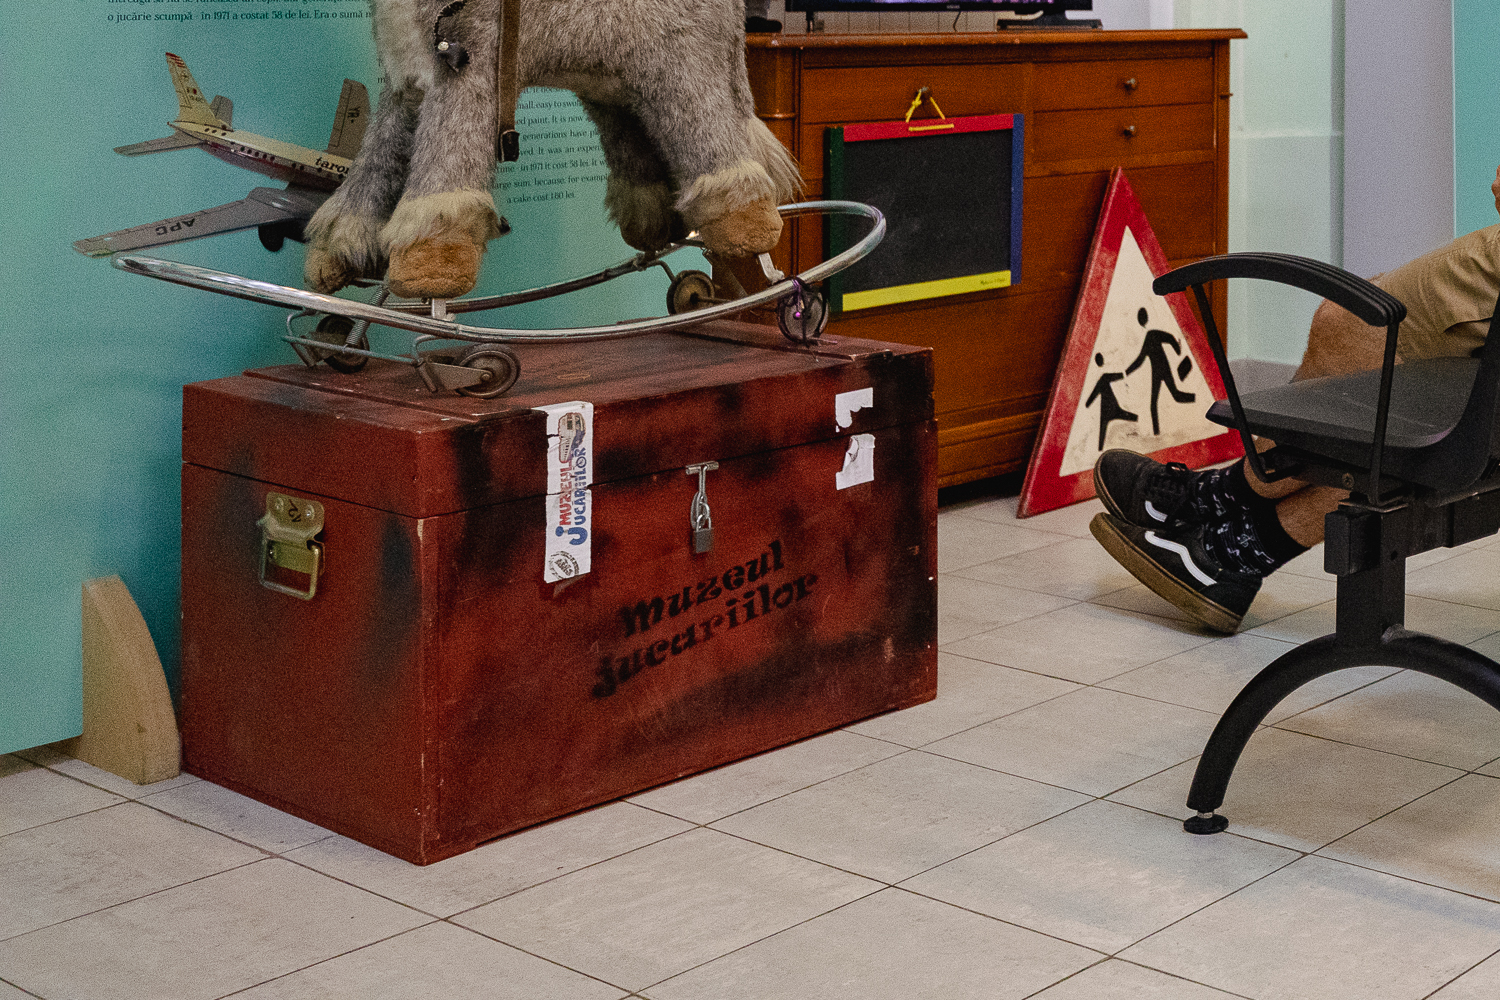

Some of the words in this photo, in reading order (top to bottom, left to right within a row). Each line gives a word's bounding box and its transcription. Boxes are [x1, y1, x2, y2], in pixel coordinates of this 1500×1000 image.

[115, 11, 152, 24] jucărie
[153, 11, 193, 23] scumpă
[213, 10, 230, 20] 1971
[239, 11, 269, 20] costat
[339, 10, 363, 19] sumă
[513, 193, 532, 204] cake
[532, 194, 549, 202] cost
[155, 217, 196, 236] APC
[617, 539, 785, 638] muzeul
